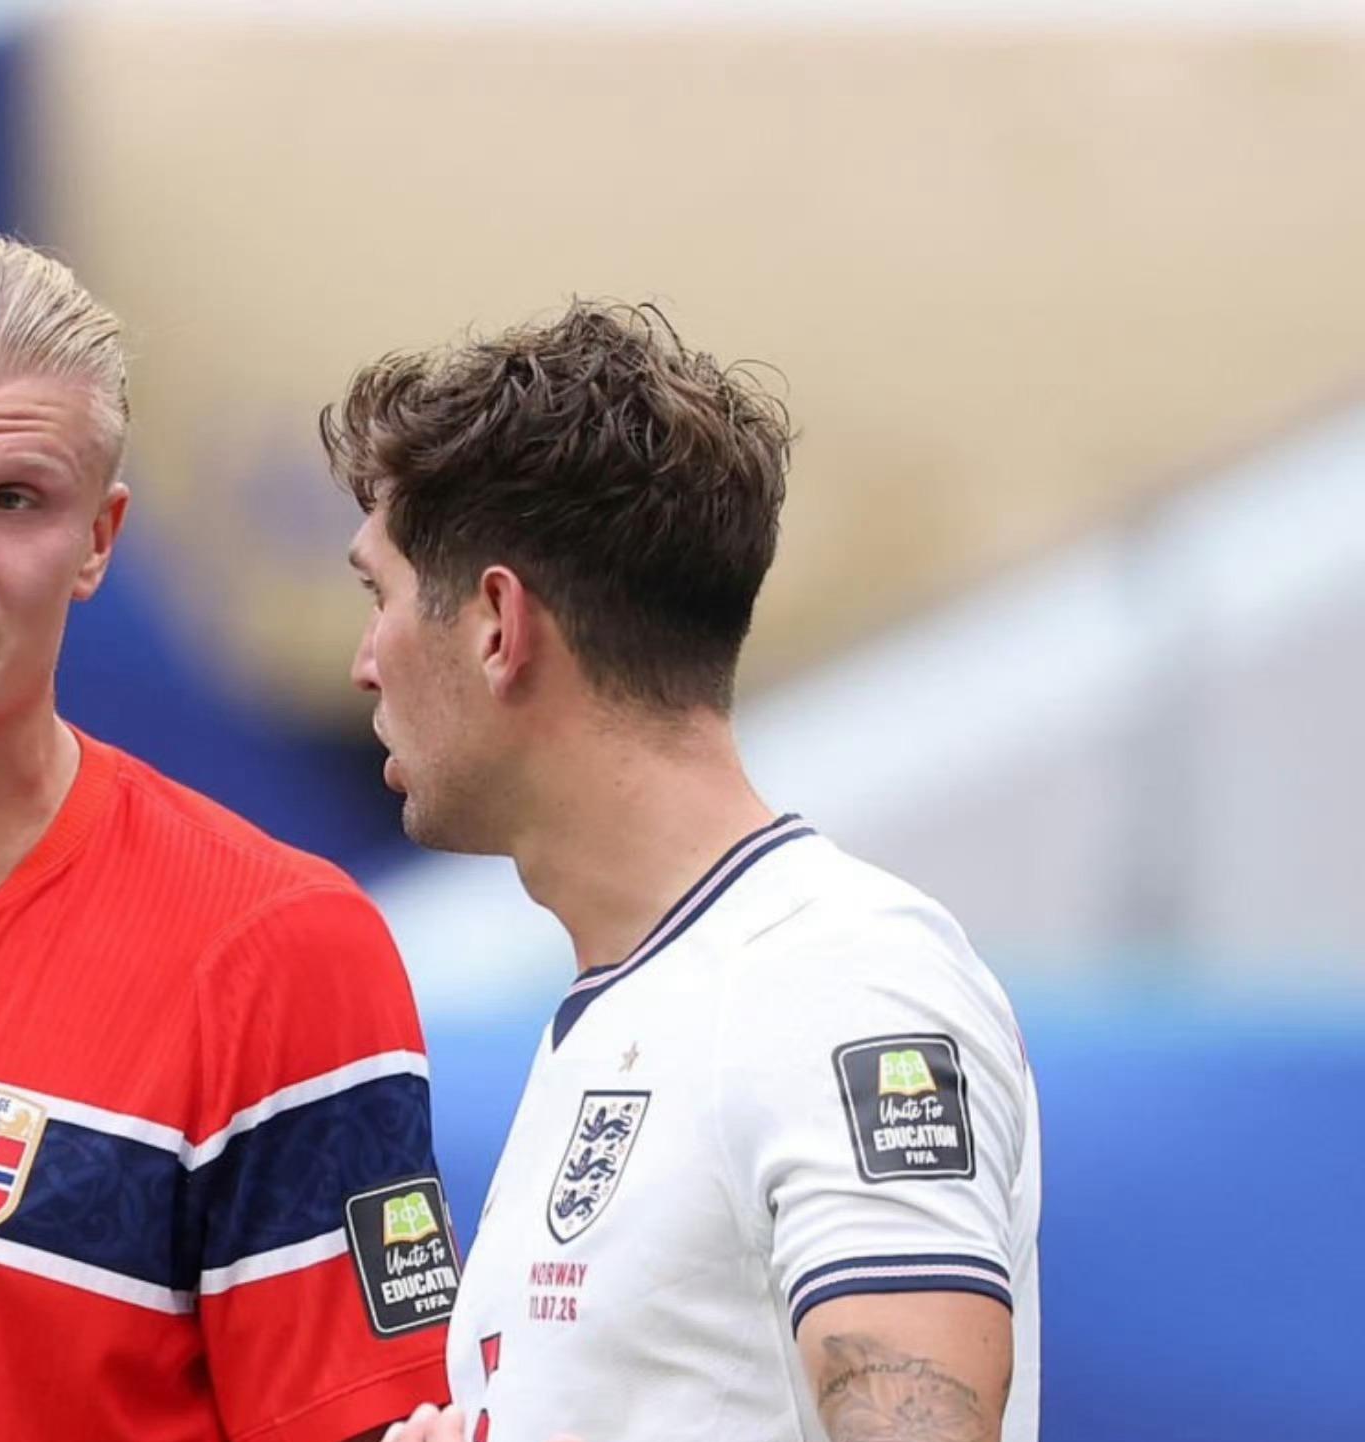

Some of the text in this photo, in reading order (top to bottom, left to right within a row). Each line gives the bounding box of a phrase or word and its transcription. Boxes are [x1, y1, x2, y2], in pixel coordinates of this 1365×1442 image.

[880, 1096, 944, 1126] Unite For
[873, 1125, 958, 1152] EDUCATION
[905, 1150, 937, 1165] FIFA
[386, 1244, 429, 1276] Unite
[530, 1262, 588, 1287] NORWAY
[415, 1294, 450, 1313] FIFA
[529, 1296, 577, 1321] 11.07.26
